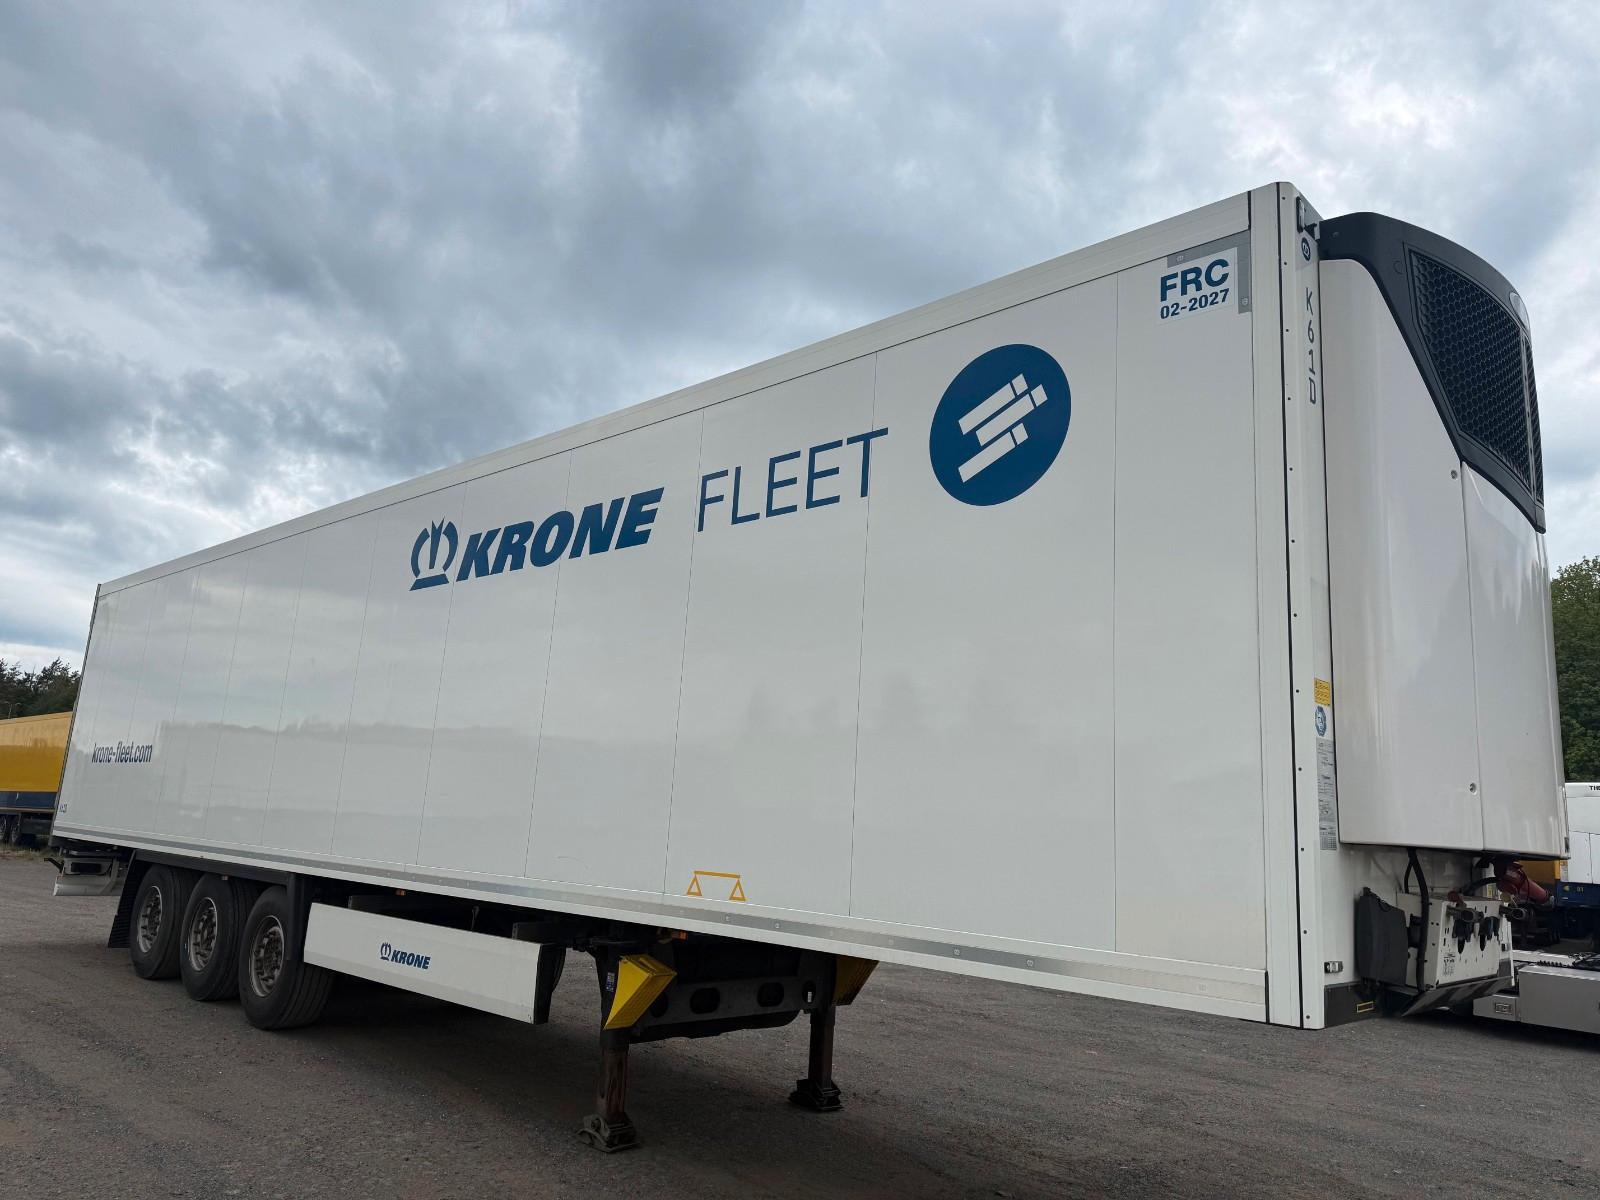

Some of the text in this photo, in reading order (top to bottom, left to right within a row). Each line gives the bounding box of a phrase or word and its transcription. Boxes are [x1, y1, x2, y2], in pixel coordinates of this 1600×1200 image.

[1160, 258, 1230, 302] FRC
[1160, 288, 1230, 320] 02-2027
[456, 427, 888, 582] KRONE FLEET
[91, 741, 153, 763] krone-fleet.com
[391, 949, 431, 970] KRONE
